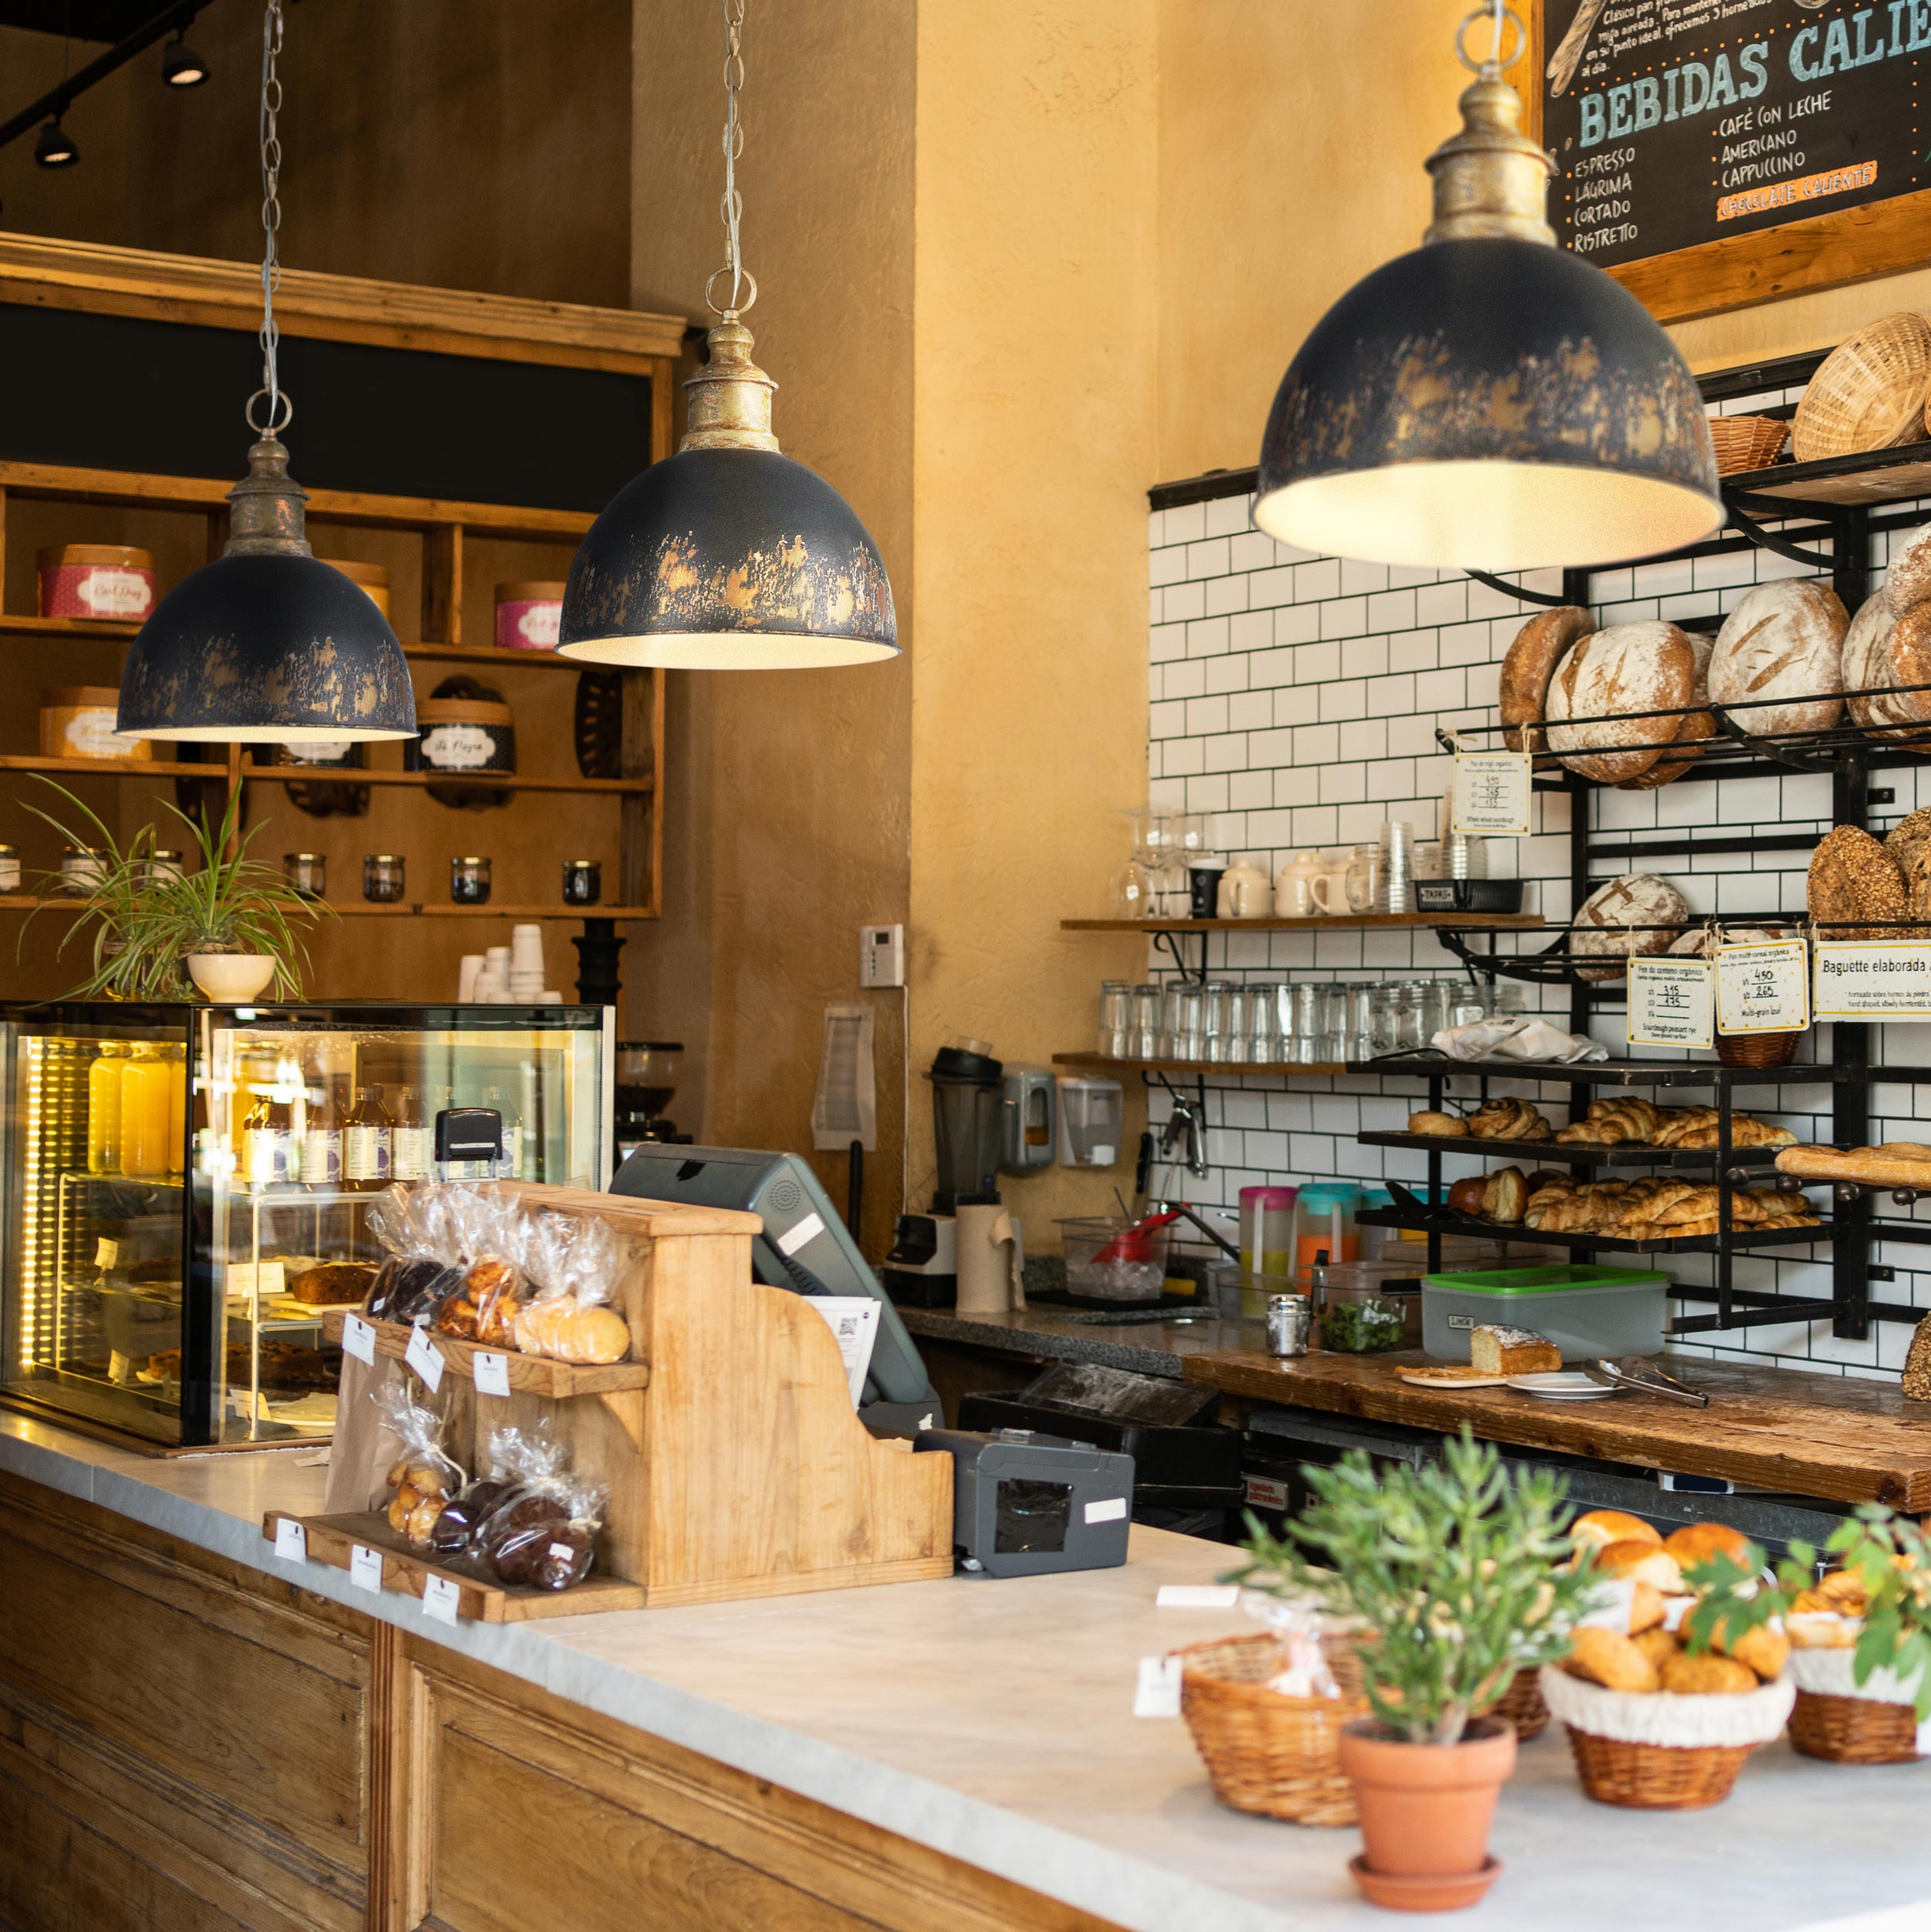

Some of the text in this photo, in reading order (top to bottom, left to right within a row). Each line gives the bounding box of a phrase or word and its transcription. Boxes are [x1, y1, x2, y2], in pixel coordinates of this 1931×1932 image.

[1636, 1, 1654, 19] pan
[1586, 49, 1598, 61] en
[1599, 46, 1610, 57] su
[1613, 36, 1637, 58] punto
[1665, 12, 1711, 41] ofrecemos
[1712, 7, 1721, 20] 3
[1598, 28, 1620, 46] miga
[1661, 7, 1682, 22] Para
[1581, 64, 1590, 77] al
[1580, 41, 1768, 148] BEBIDAS
[1719, 90, 1833, 137] CAFÉ CON LECHE
[1575, 147, 1635, 178] ESPRESSO
[1721, 129, 1797, 165] AMERICANO
[1722, 151, 1806, 188] CAPPUCCINO
[1575, 172, 1632, 203] LÁGRIMA
[1721, 165, 1874, 216] CHOCOLATE CALIENTE
[1574, 199, 1631, 227] CORTADO
[1574, 222, 1638, 253] RISTRETTO
[1754, 968, 1774, 982] 450
[1823, 958, 1926, 976] Baguette elaborada
[1756, 986, 1774, 997] 265
